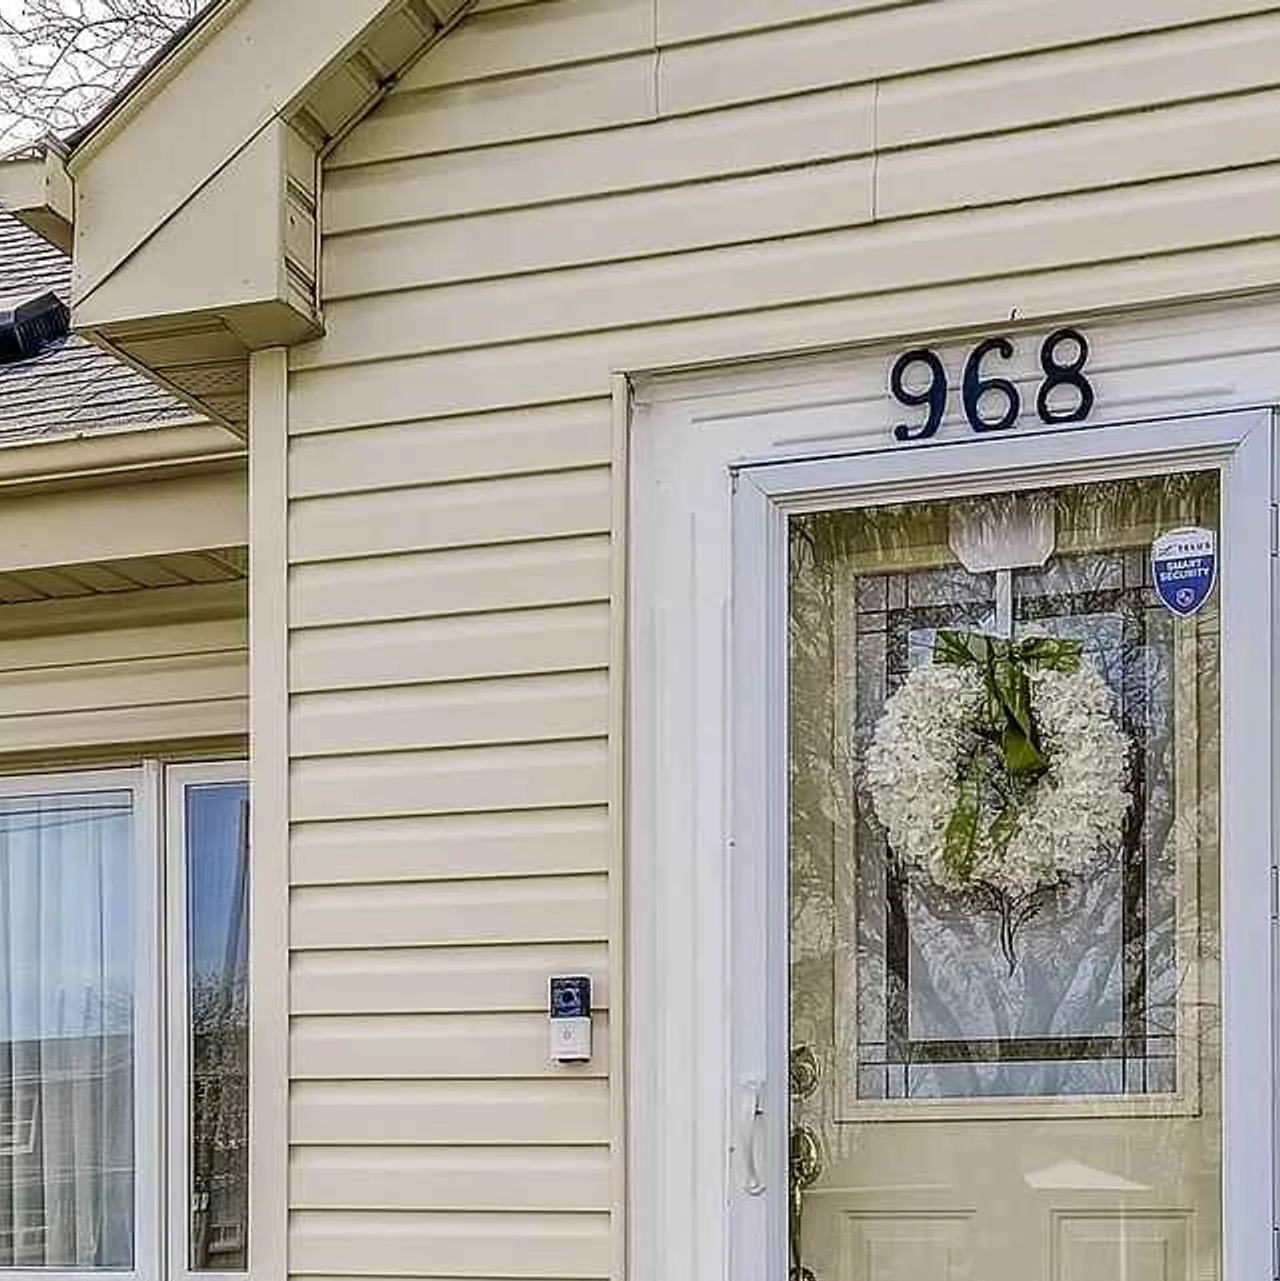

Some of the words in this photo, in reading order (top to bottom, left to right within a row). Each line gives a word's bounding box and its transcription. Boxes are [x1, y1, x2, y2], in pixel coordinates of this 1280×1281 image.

[891, 328, 1094, 441] 968
[1166, 559, 1201, 571] SMART
[1160, 567, 1209, 581] SECURITY
